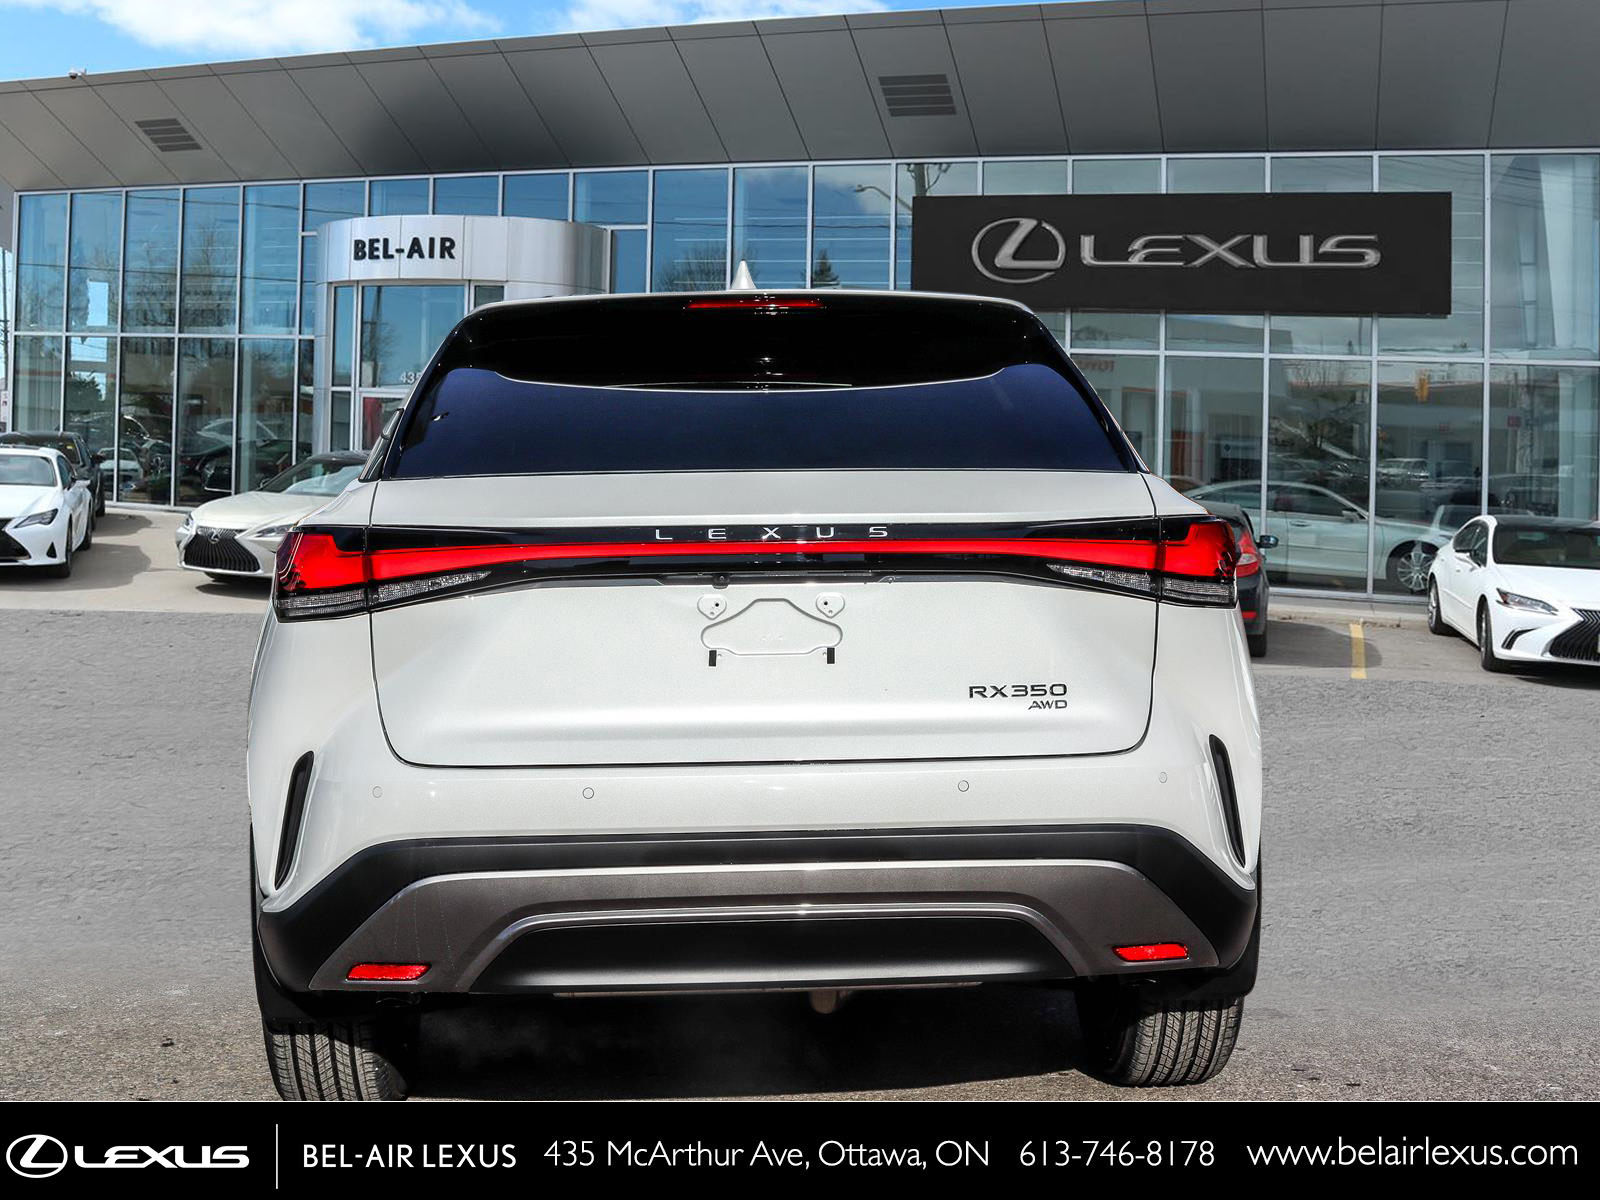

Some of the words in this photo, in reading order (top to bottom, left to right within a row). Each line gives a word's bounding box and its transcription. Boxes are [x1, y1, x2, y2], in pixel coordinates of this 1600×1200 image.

[353, 237, 457, 261] BEL-AIR
[1080, 233, 1382, 269] LEXUS
[655, 526, 889, 541] LEXUS
[969, 683, 1068, 699] RX350
[1028, 699, 1068, 710] AWD
